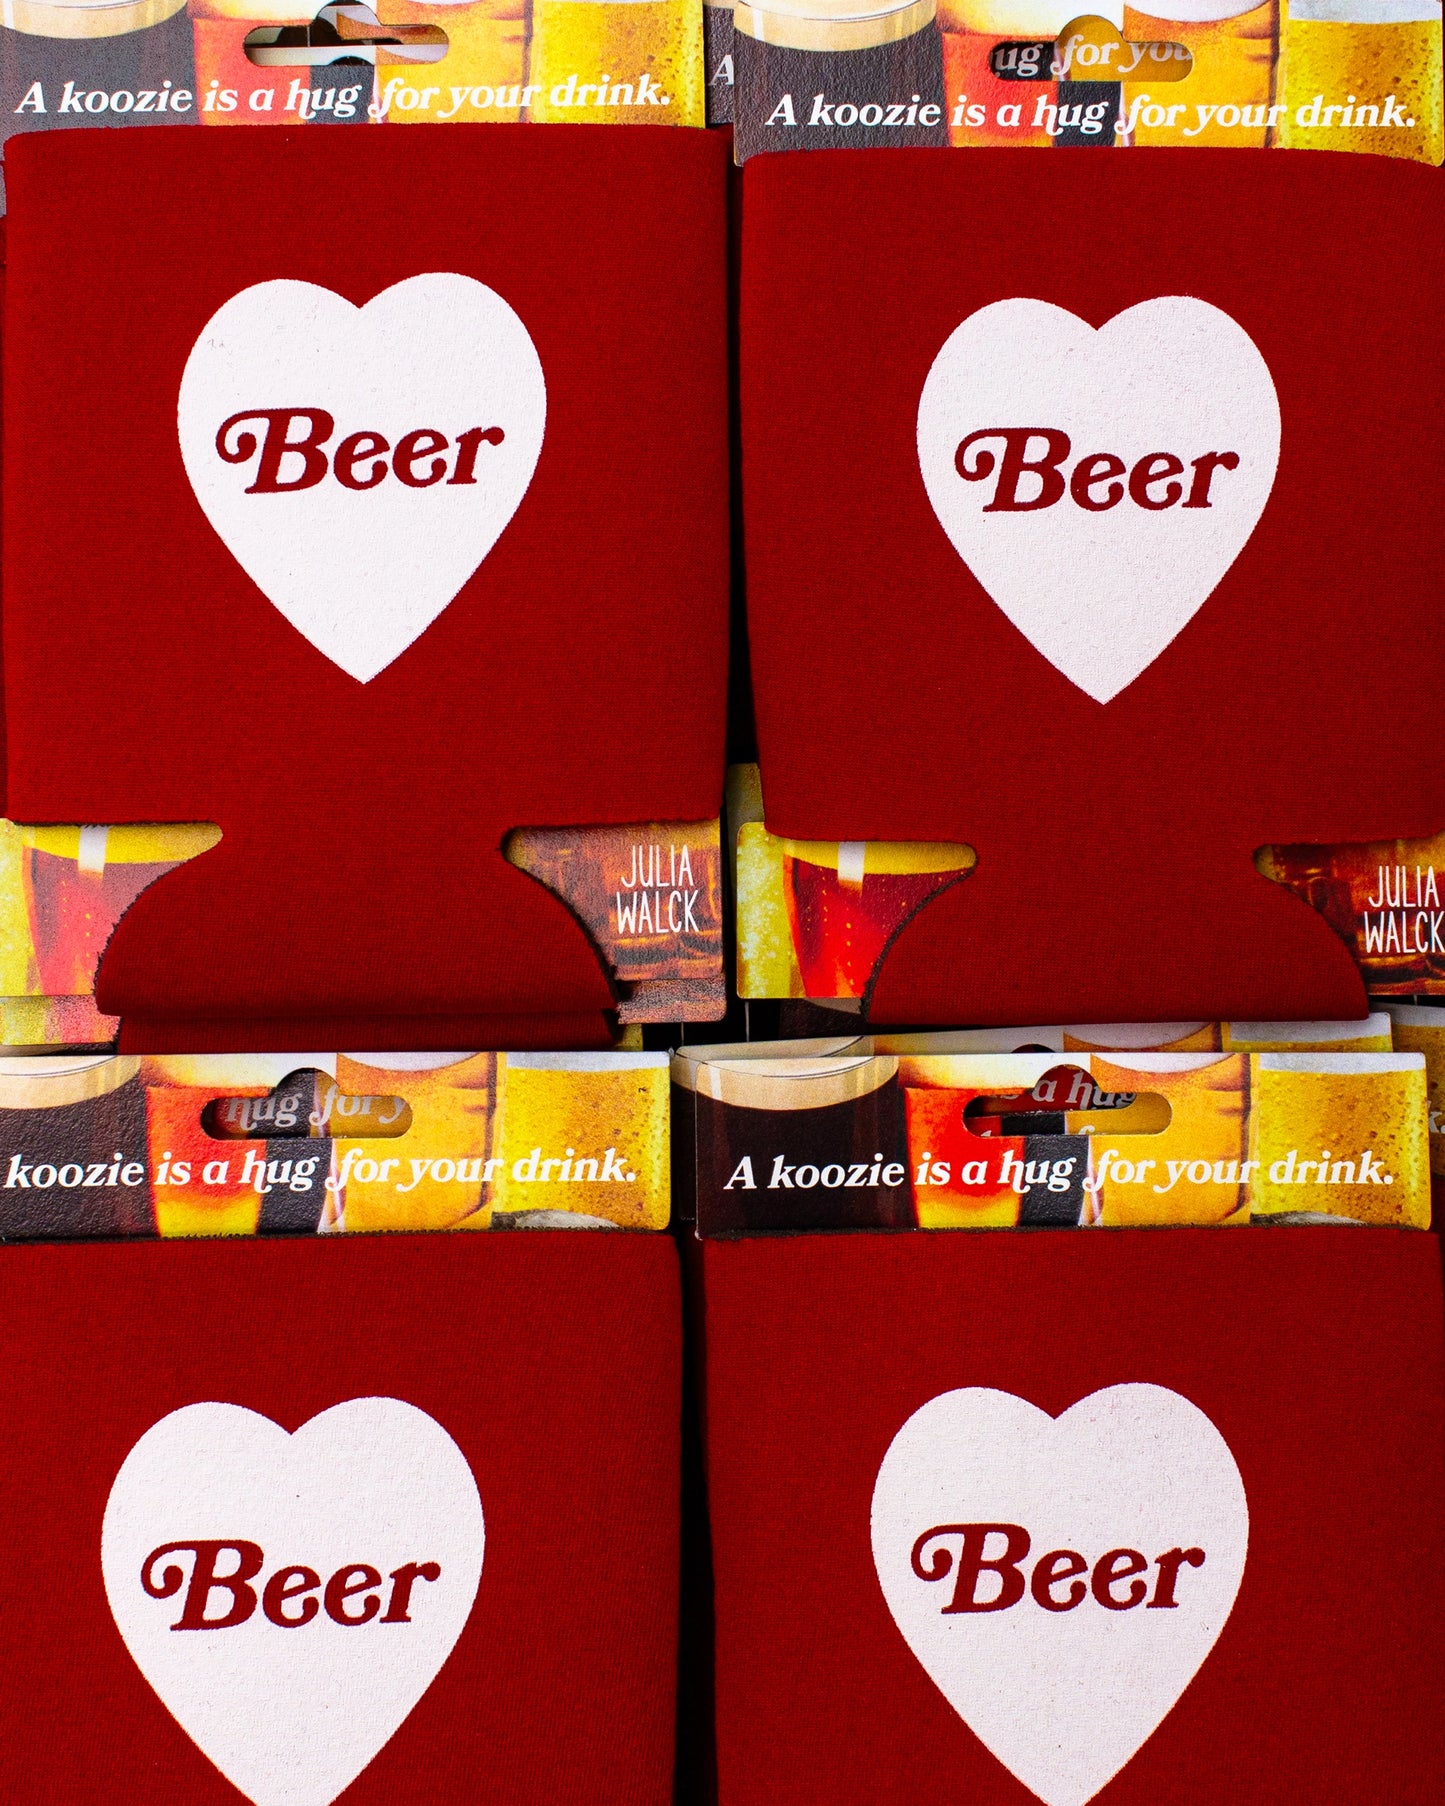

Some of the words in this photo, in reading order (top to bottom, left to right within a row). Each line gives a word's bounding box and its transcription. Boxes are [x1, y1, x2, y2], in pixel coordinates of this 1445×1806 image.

[989, 43, 1044, 78] ug
[1050, 34, 1119, 75] for
[14, 82, 47, 114] A
[57, 80, 193, 113] koozie
[203, 80, 238, 112] is
[248, 88, 275, 112] a
[283, 78, 363, 120] hug
[369, 79, 440, 118] for
[437, 85, 542, 118] your
[550, 74, 670, 107] drink.
[765, 94, 797, 126] A
[807, 93, 941, 127] koozie
[951, 94, 986, 127] is
[997, 104, 1022, 127] a
[1031, 94, 1109, 136] hug
[1113, 94, 1186, 135] for
[1183, 104, 1287, 136] your
[1297, 95, 1415, 127] drink.
[216, 407, 506, 495] Beer
[954, 426, 1240, 512] Beer
[621, 845, 694, 888] JULIA
[1368, 865, 1440, 908] JULIA
[616, 890, 700, 934] WALCK
[1364, 911, 1445, 953] WALCK
[3, 1152, 145, 1188] koozie
[154, 1151, 191, 1186] is
[202, 1160, 229, 1185] a
[238, 1149, 320, 1193] hug
[325, 1148, 400, 1192] for
[397, 1158, 504, 1192] your
[514, 1147, 636, 1182] drink.
[724, 1156, 757, 1190] A
[767, 1153, 905, 1189] koozie
[914, 1151, 951, 1186] is
[961, 1161, 988, 1186] a
[997, 1149, 1077, 1193] hug
[1083, 1150, 1157, 1192] for
[1153, 1160, 1260, 1193] your
[1269, 1150, 1393, 1184] drink.
[140, 1539, 442, 1632] Beer
[910, 1522, 1206, 1615] Beer
